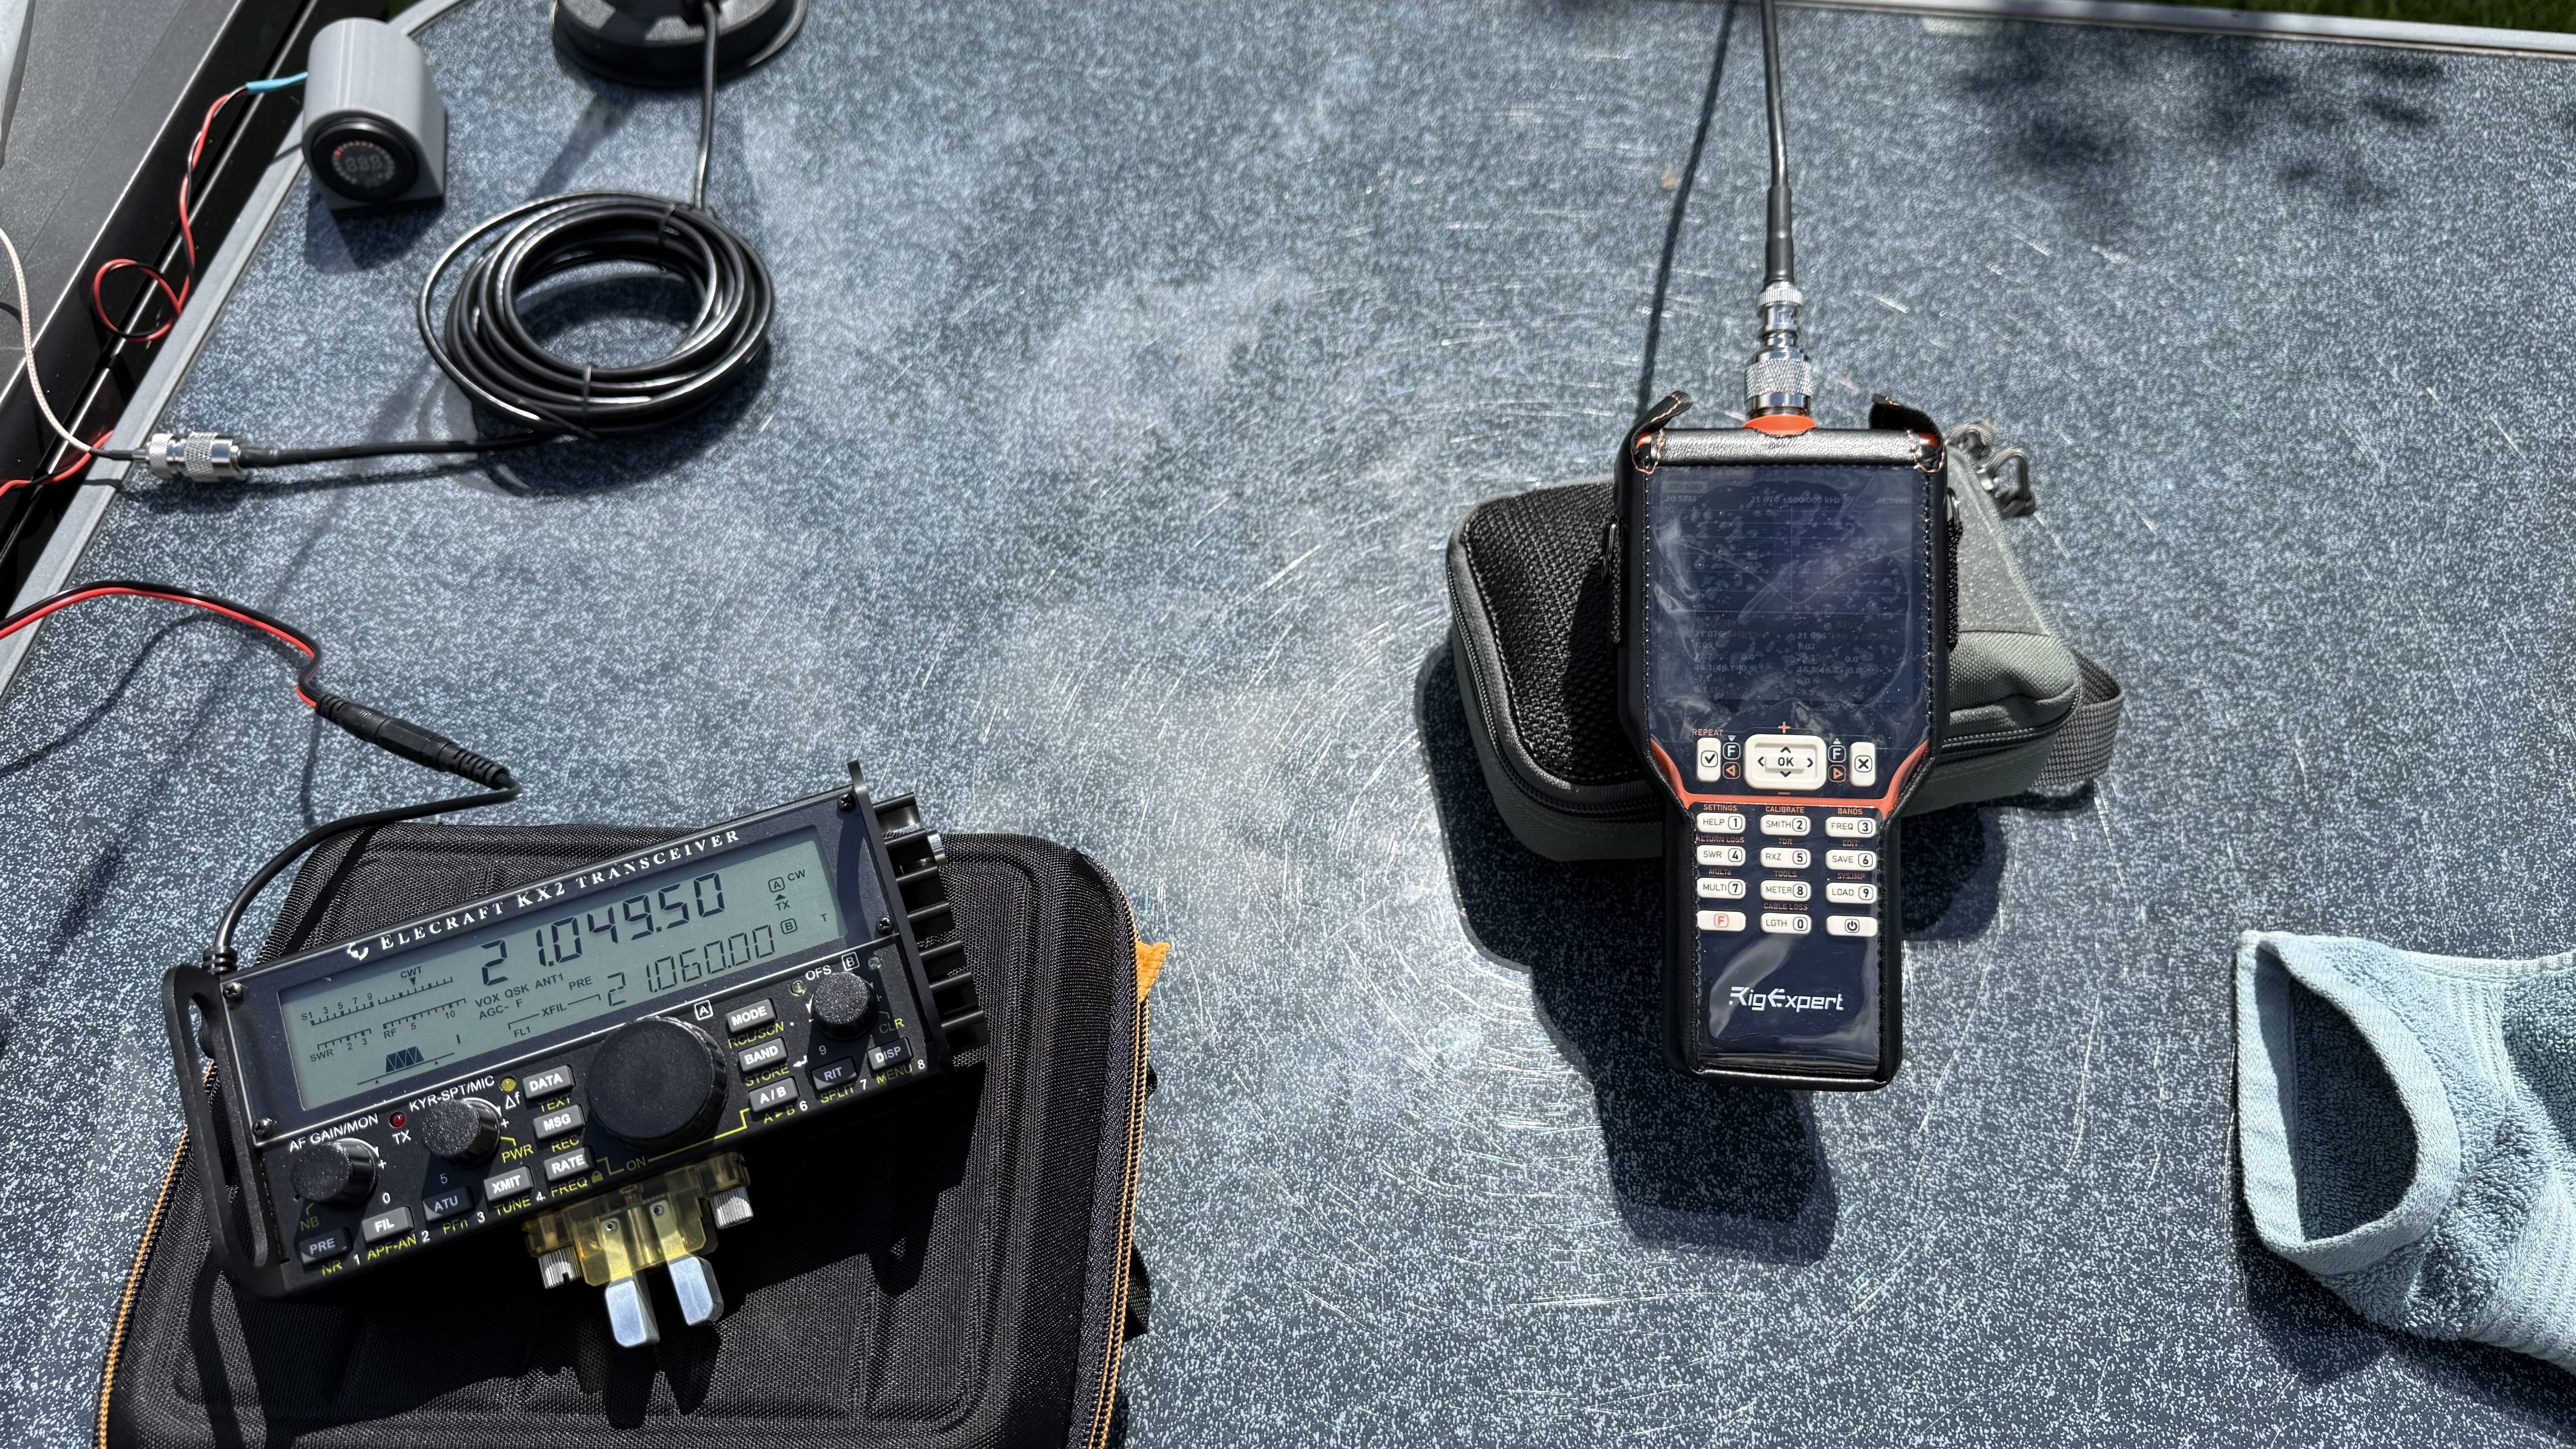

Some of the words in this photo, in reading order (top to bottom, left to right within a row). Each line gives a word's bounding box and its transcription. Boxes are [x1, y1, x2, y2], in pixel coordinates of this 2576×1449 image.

[1692, 728, 1724, 736] REPEAT
[1728, 745, 1735, 757] F
[1833, 749, 1841, 759] F
[1777, 757, 1794, 767] OK
[1796, 820, 1803, 830] 2
[1862, 822, 1869, 832] 3
[1732, 850, 1739, 860] 4
[1797, 853, 1803, 863] 5
[1863, 855, 1869, 865] 6
[787, 869, 806, 881] CW
[381, 902, 504, 950] ELECRAFT
[516, 882, 565, 908] KX2
[575, 830, 740, 889] TRANSCEIVER
[1732, 883, 1739, 893] 7
[1766, 886, 1792, 894] METER
[1797, 886, 1803, 896] 8
[1863, 888, 1869, 898] 9
[775, 900, 791, 911] TX
[820, 913, 828, 922] T
[1717, 915, 1725, 925] F
[1797, 919, 1803, 929] 0
[400, 966, 422, 978] CWT
[805, 965, 832, 981] OFS
[475, 993, 501, 1007] VOX
[505, 984, 530, 998] QSK
[535, 973, 564, 989] ANT1
[569, 976, 593, 990] PRE
[515, 998, 523, 1008] F
[1728, 986, 1845, 1013] RigExpert
[301, 1012, 313, 1021] S1
[542, 1003, 567, 1017] XFIL
[731, 1006, 768, 1026] MODE
[384, 1028, 397, 1039] RF
[445, 1010, 455, 1019] 10
[513, 1026, 531, 1038] FL1
[879, 1018, 906, 1034] CLR
[310, 1049, 334, 1062] SWR
[347, 1043, 354, 1051] 2
[744, 1045, 778, 1065] BAND
[819, 1045, 827, 1055] 9
[875, 1046, 902, 1063] DISP
[917, 1059, 925, 1070] 8
[745, 1064, 790, 1087] STORE
[824, 1067, 842, 1081] RIT
[876, 1064, 913, 1084] MENU
[529, 1073, 563, 1091] DATA
[860, 1079, 867, 1090] 7
[409, 1076, 495, 1113] KYR-SPT/MIC
[760, 1086, 787, 1104] A/B
[820, 1084, 854, 1103] SPLIT
[538, 1093, 571, 1113] TEXT
[799, 1100, 808, 1112] 6
[543, 1114, 572, 1132] MSG
[289, 1136, 306, 1153] AF
[310, 1113, 379, 1145] GAIN/MON
[392, 1129, 412, 1145] TX
[552, 1135, 580, 1153] REC
[501, 1144, 534, 1163] PWR
[551, 1154, 586, 1174] RATE
[626, 1155, 647, 1172] ON
[440, 1173, 448, 1184] 5
[492, 1174, 521, 1194] XMIT
[551, 1177, 589, 1197] FREQ
[382, 1192, 391, 1204] 0
[434, 1196, 459, 1212] ATU
[495, 1196, 532, 1216] TUNE
[300, 1216, 320, 1231] NB
[476, 1211, 486, 1223] 3
[374, 1218, 395, 1233] FIL
[443, 1218, 469, 1234] PFn
[421, 1230, 431, 1243] 2
[309, 1238, 336, 1255] PRE
[367, 1233, 417, 1261] APF-AN
[353, 1254, 360, 1265] 1
[322, 1261, 343, 1276] NR
